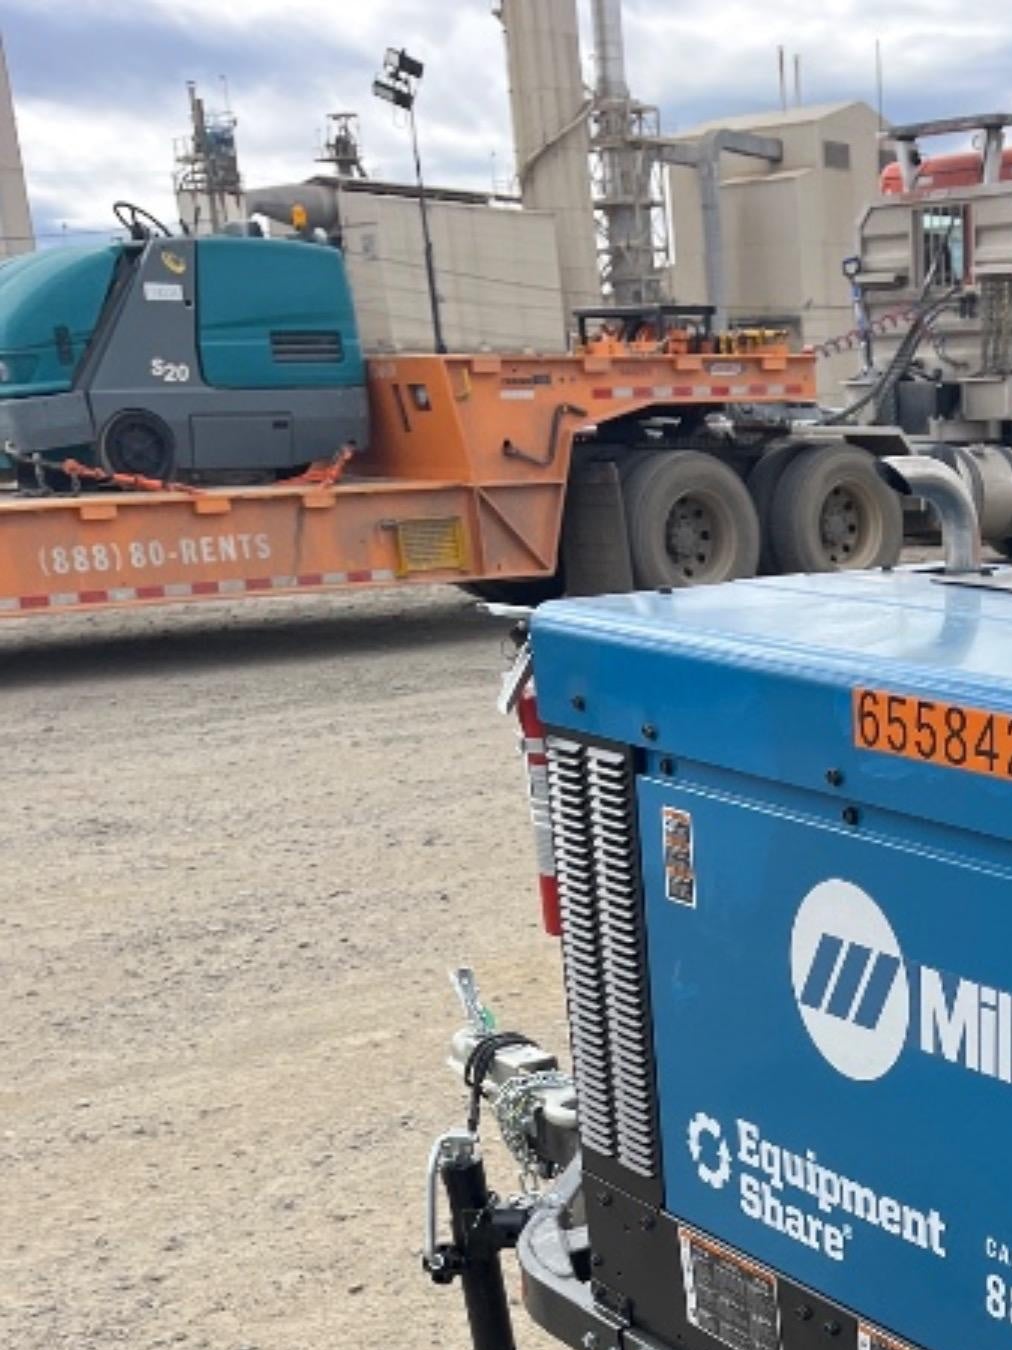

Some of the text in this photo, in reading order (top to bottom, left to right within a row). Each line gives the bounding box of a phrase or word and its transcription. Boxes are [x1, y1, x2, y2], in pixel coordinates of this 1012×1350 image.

[151, 358, 190, 382] S20
[38, 533, 271, 575] (888) 80-RENTS
[736, 1117, 946, 1258] Equipment
[740, 1172, 845, 1261] Share
